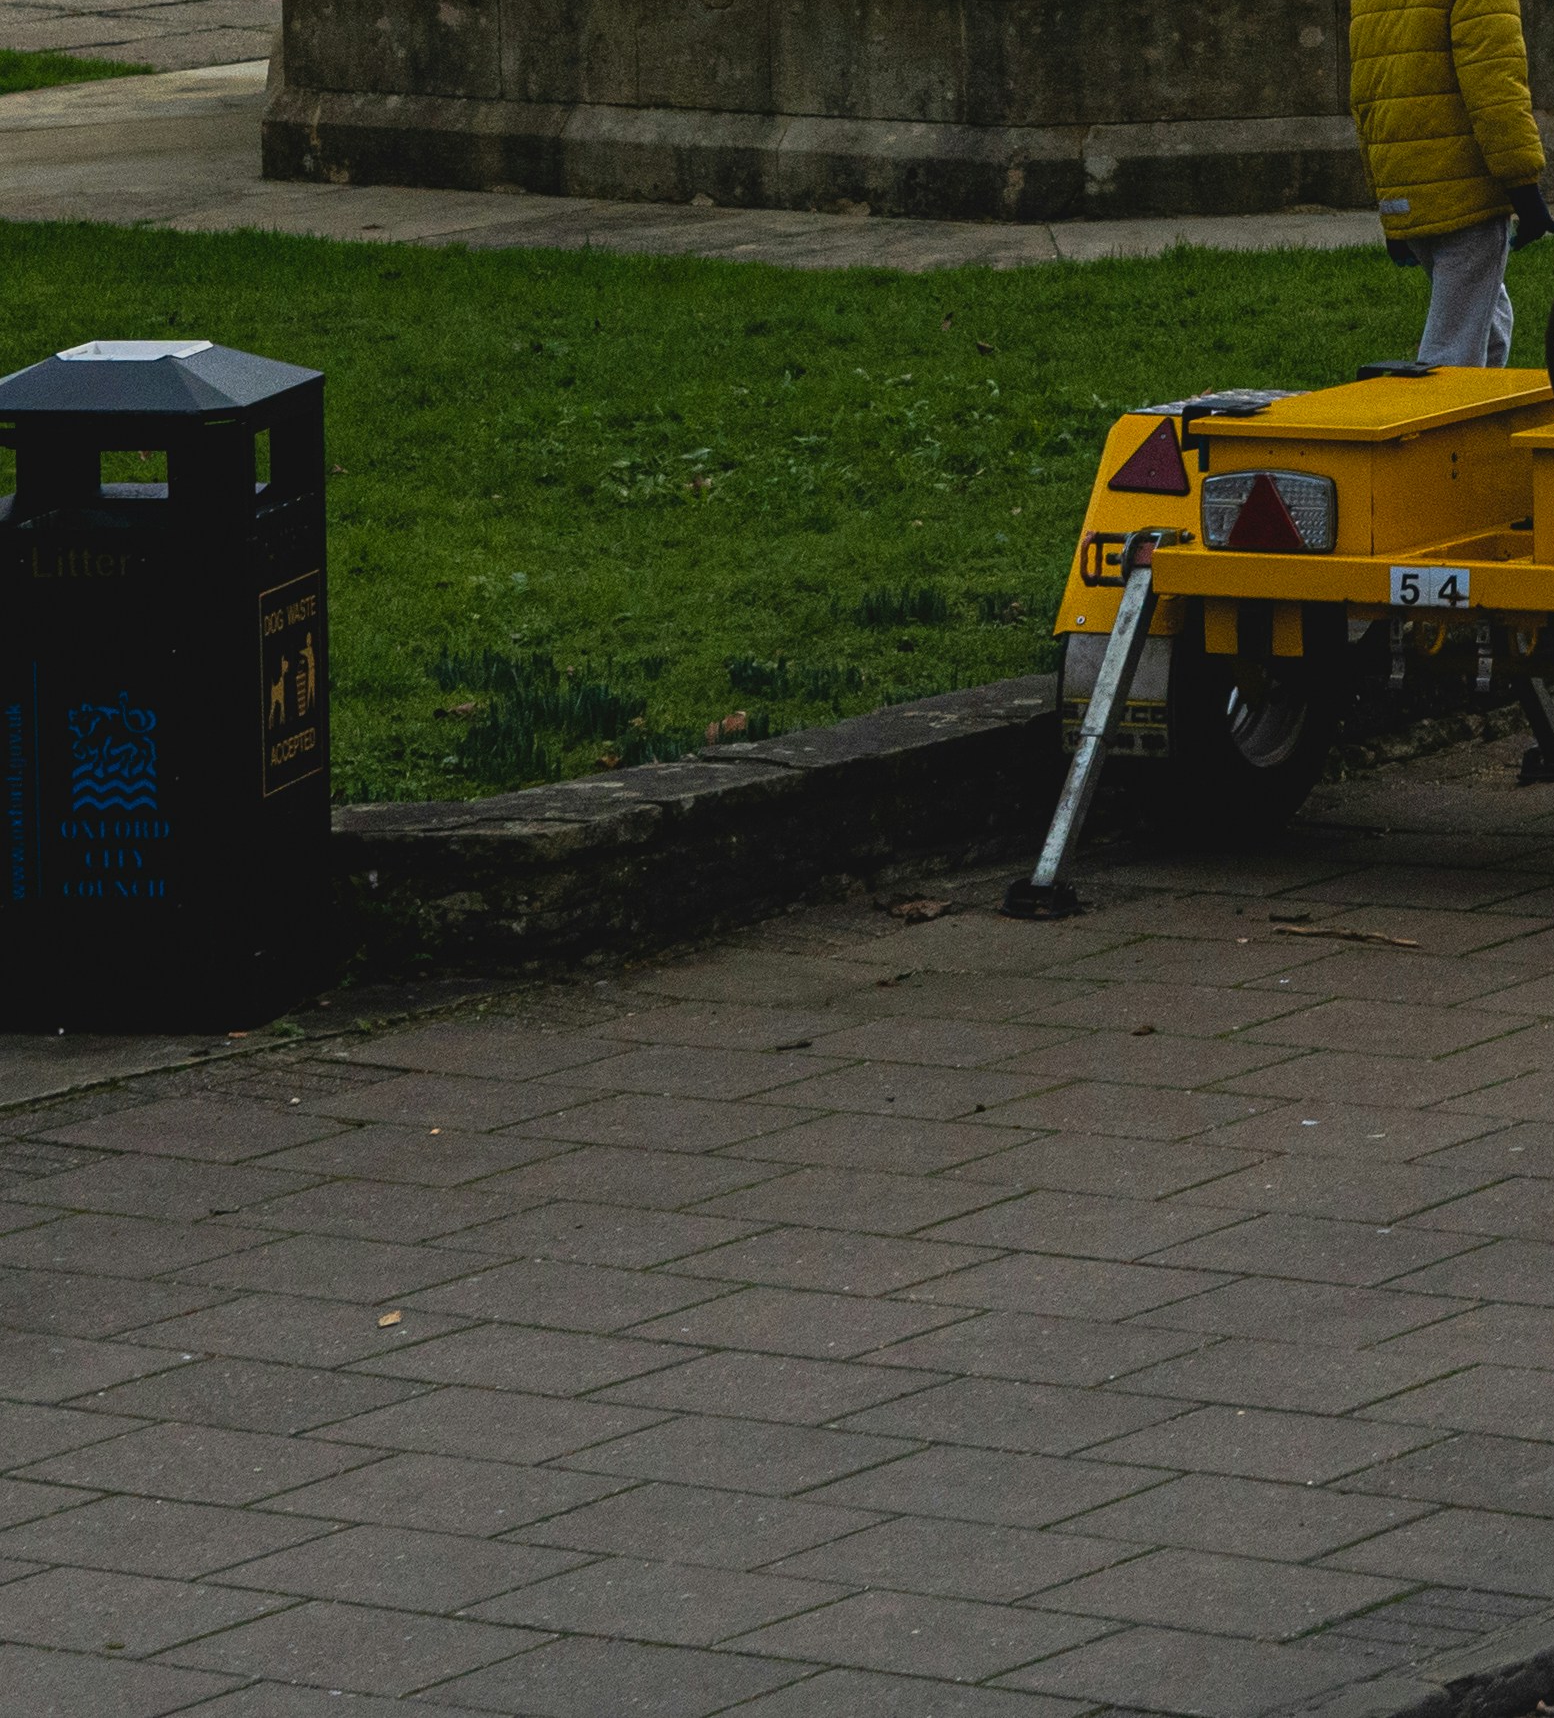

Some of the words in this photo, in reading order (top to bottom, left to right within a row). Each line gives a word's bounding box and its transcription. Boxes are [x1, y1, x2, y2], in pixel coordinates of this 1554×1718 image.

[31, 546, 131, 578] Litter
[263, 608, 284, 636] DOG
[286, 594, 316, 625] WASTE
[270, 727, 316, 766] ACCEPTED
[59, 818, 171, 841] OXFORD
[84, 848, 144, 871] CITY
[62, 879, 167, 899] COUNCIL
